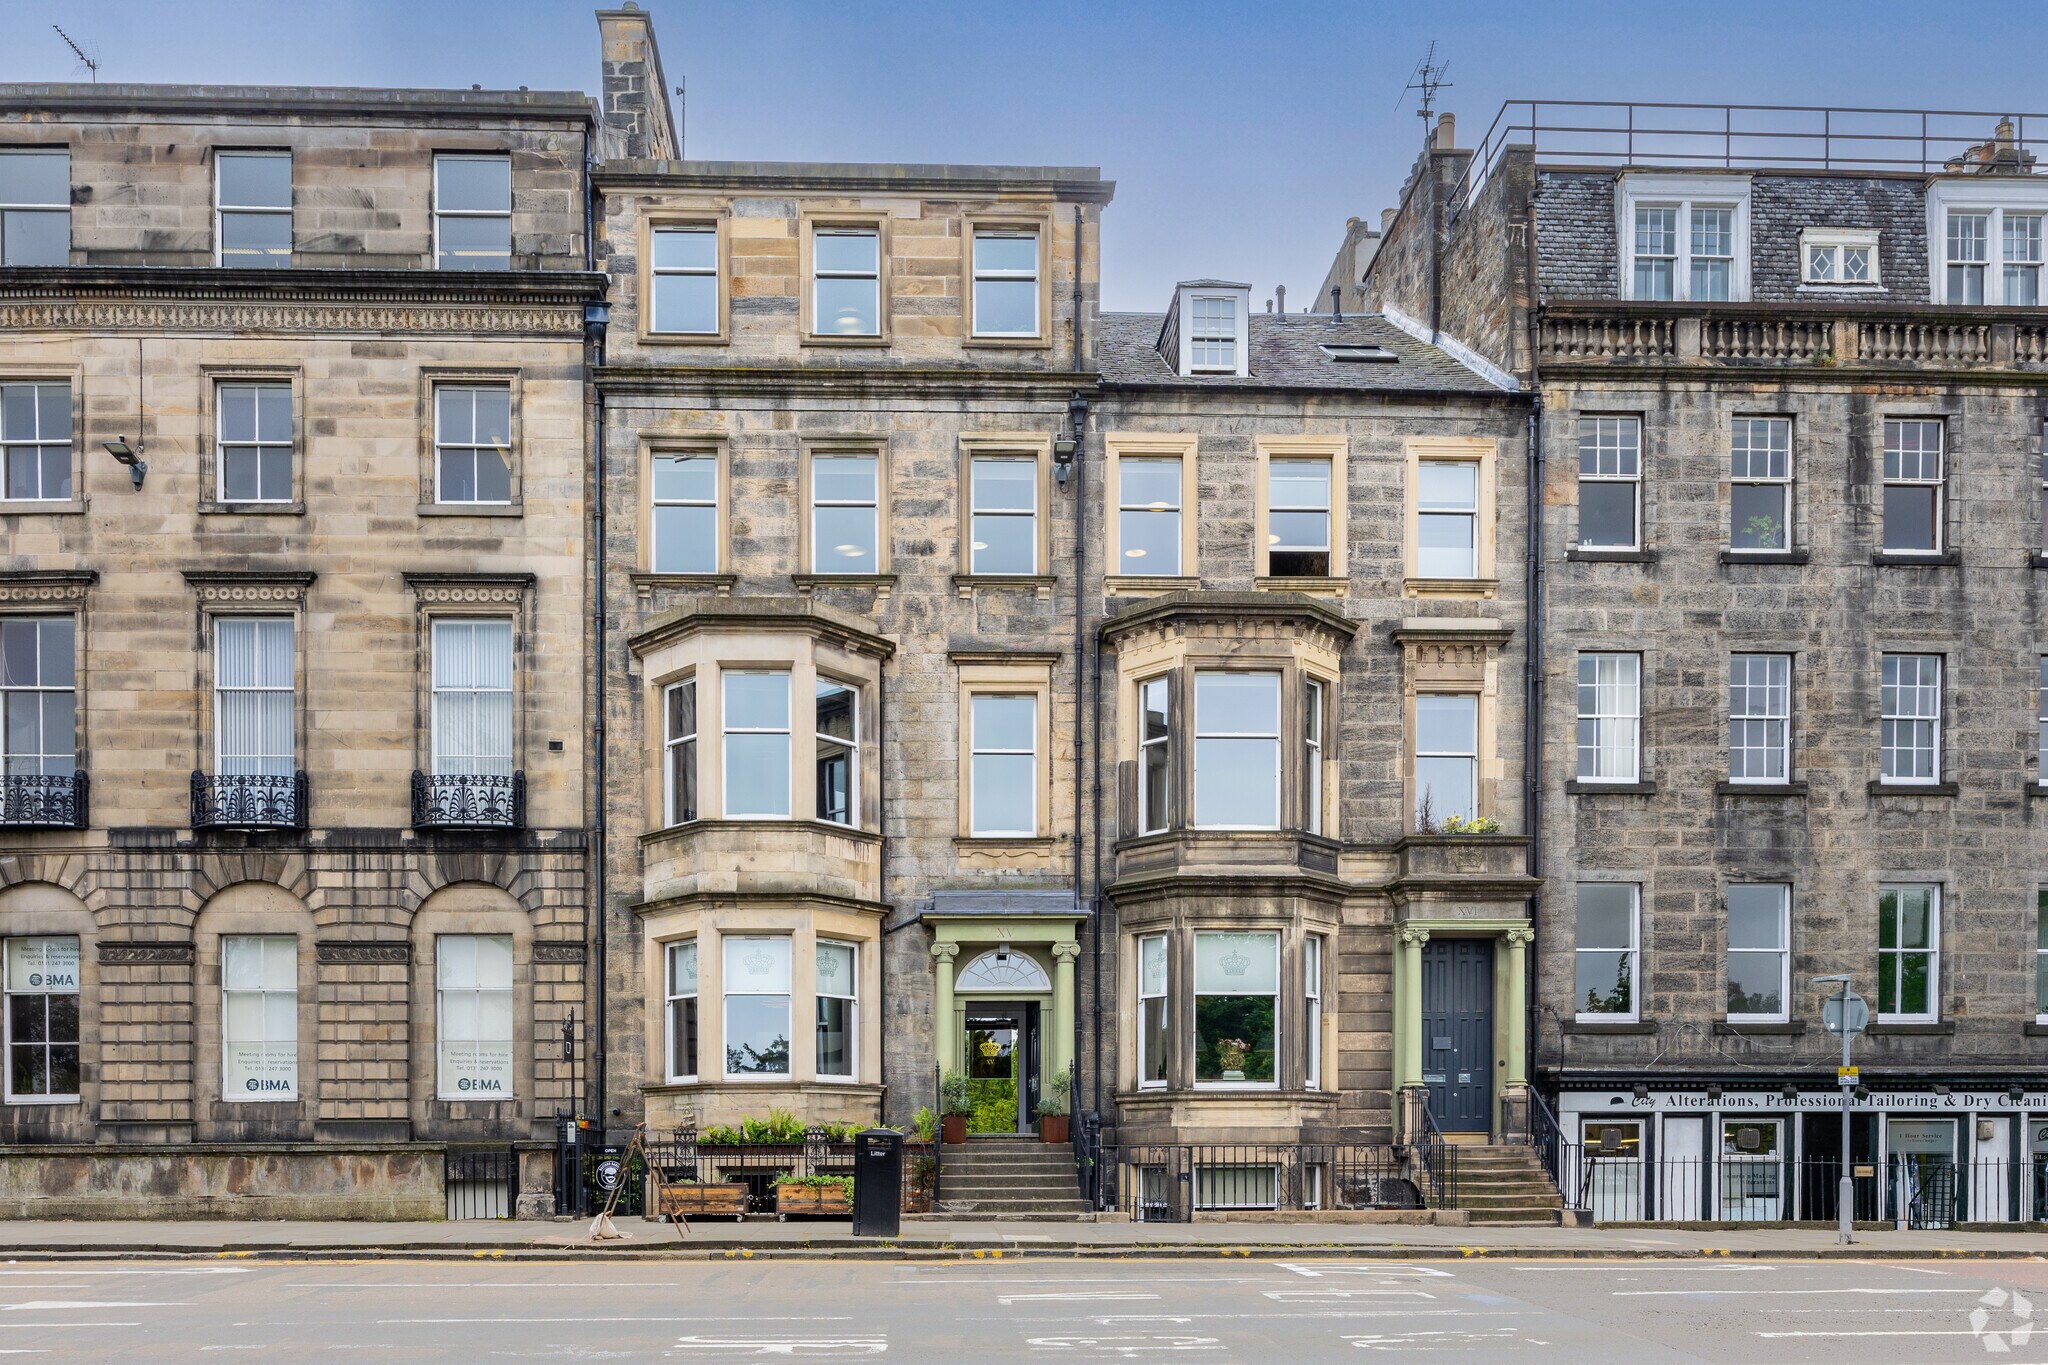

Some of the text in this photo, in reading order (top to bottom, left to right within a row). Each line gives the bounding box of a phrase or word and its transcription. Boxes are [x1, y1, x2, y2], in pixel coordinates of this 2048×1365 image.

[1458, 906, 1477, 915] XVI
[997, 928, 1014, 938] XV
[45, 974, 74, 985] BMA
[261, 1080, 290, 1090] BMA
[472, 1080, 501, 1091] BMA
[1631, 1096, 1657, 1109] City
[1665, 1094, 1759, 1109] Alterations,
[1766, 1094, 1860, 1107] Professional
[1868, 1094, 1938, 1110] Tailoring
[1944, 1094, 1957, 1107] &
[1964, 1094, 1992, 1110] Dry
